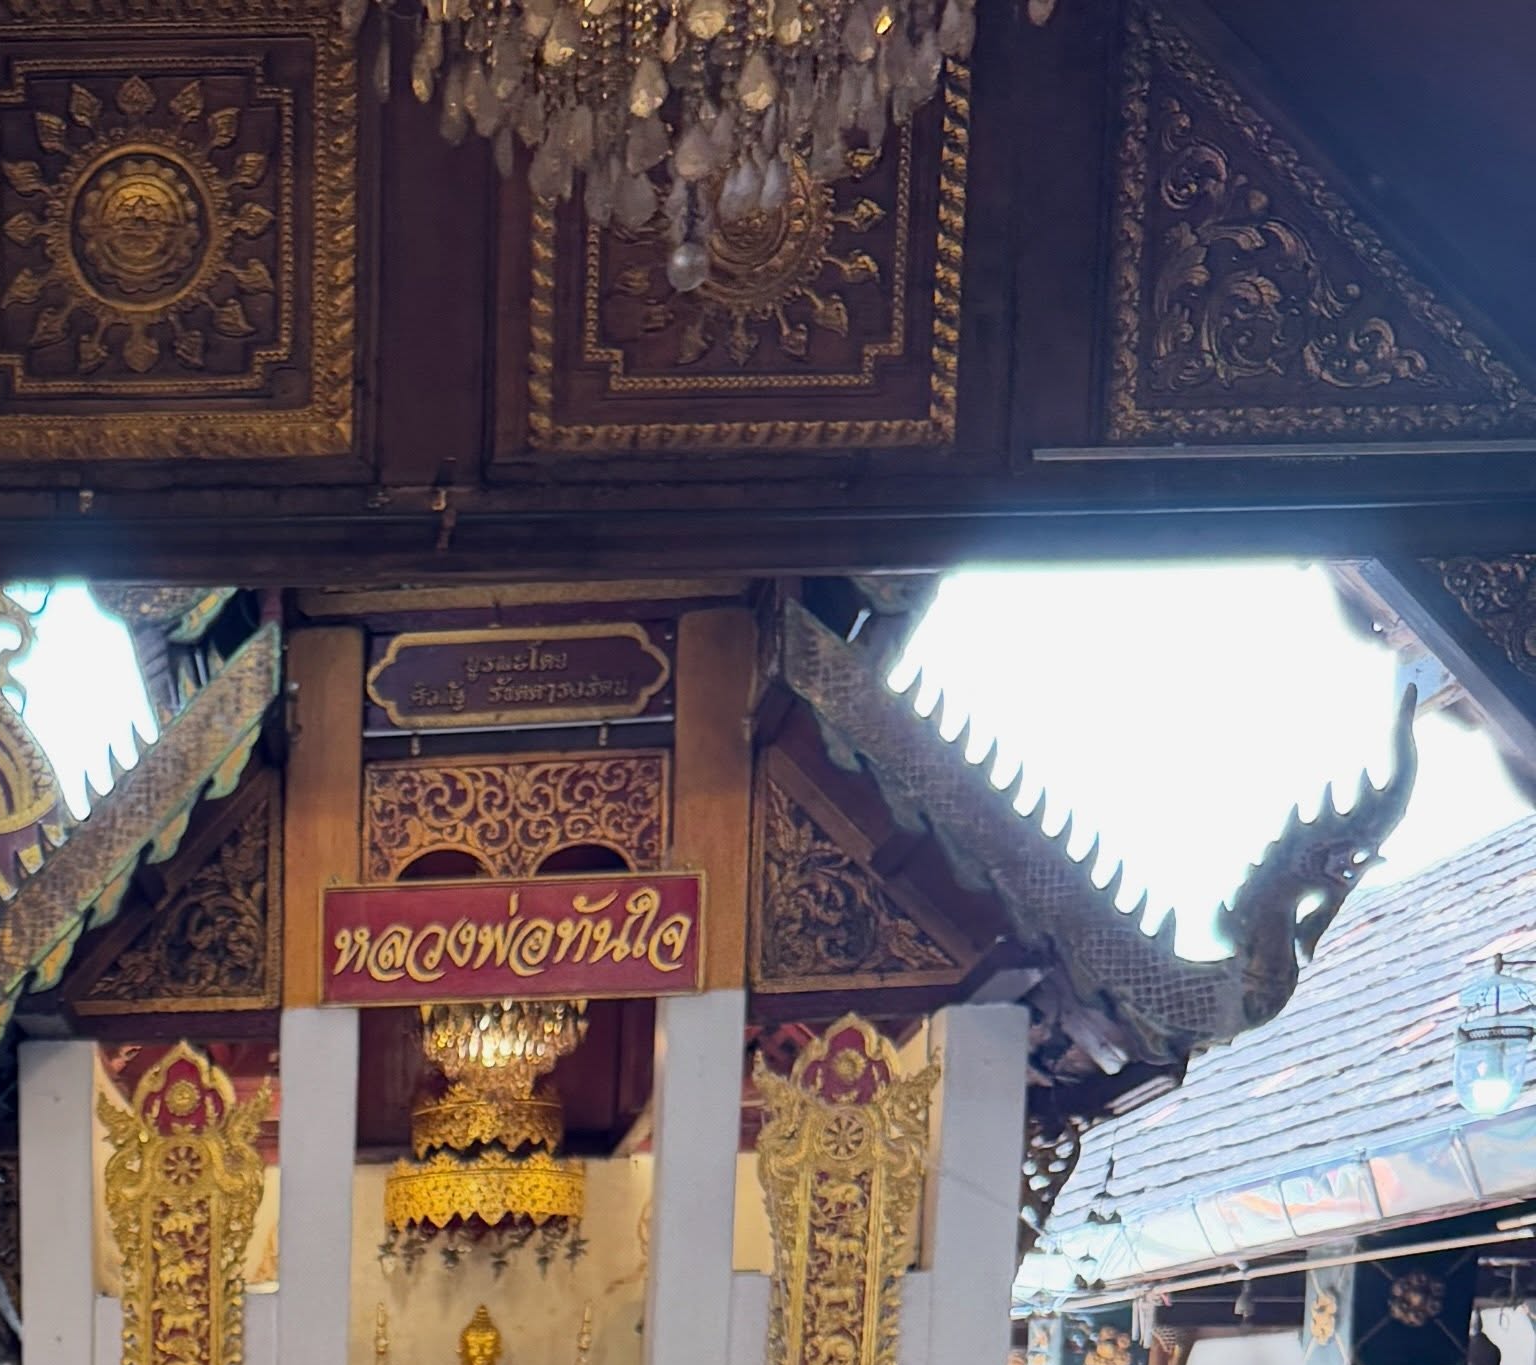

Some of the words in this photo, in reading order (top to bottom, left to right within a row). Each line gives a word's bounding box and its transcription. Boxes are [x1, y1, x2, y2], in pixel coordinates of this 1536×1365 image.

[332, 886, 693, 983] หลวงพ่อทันใจ
